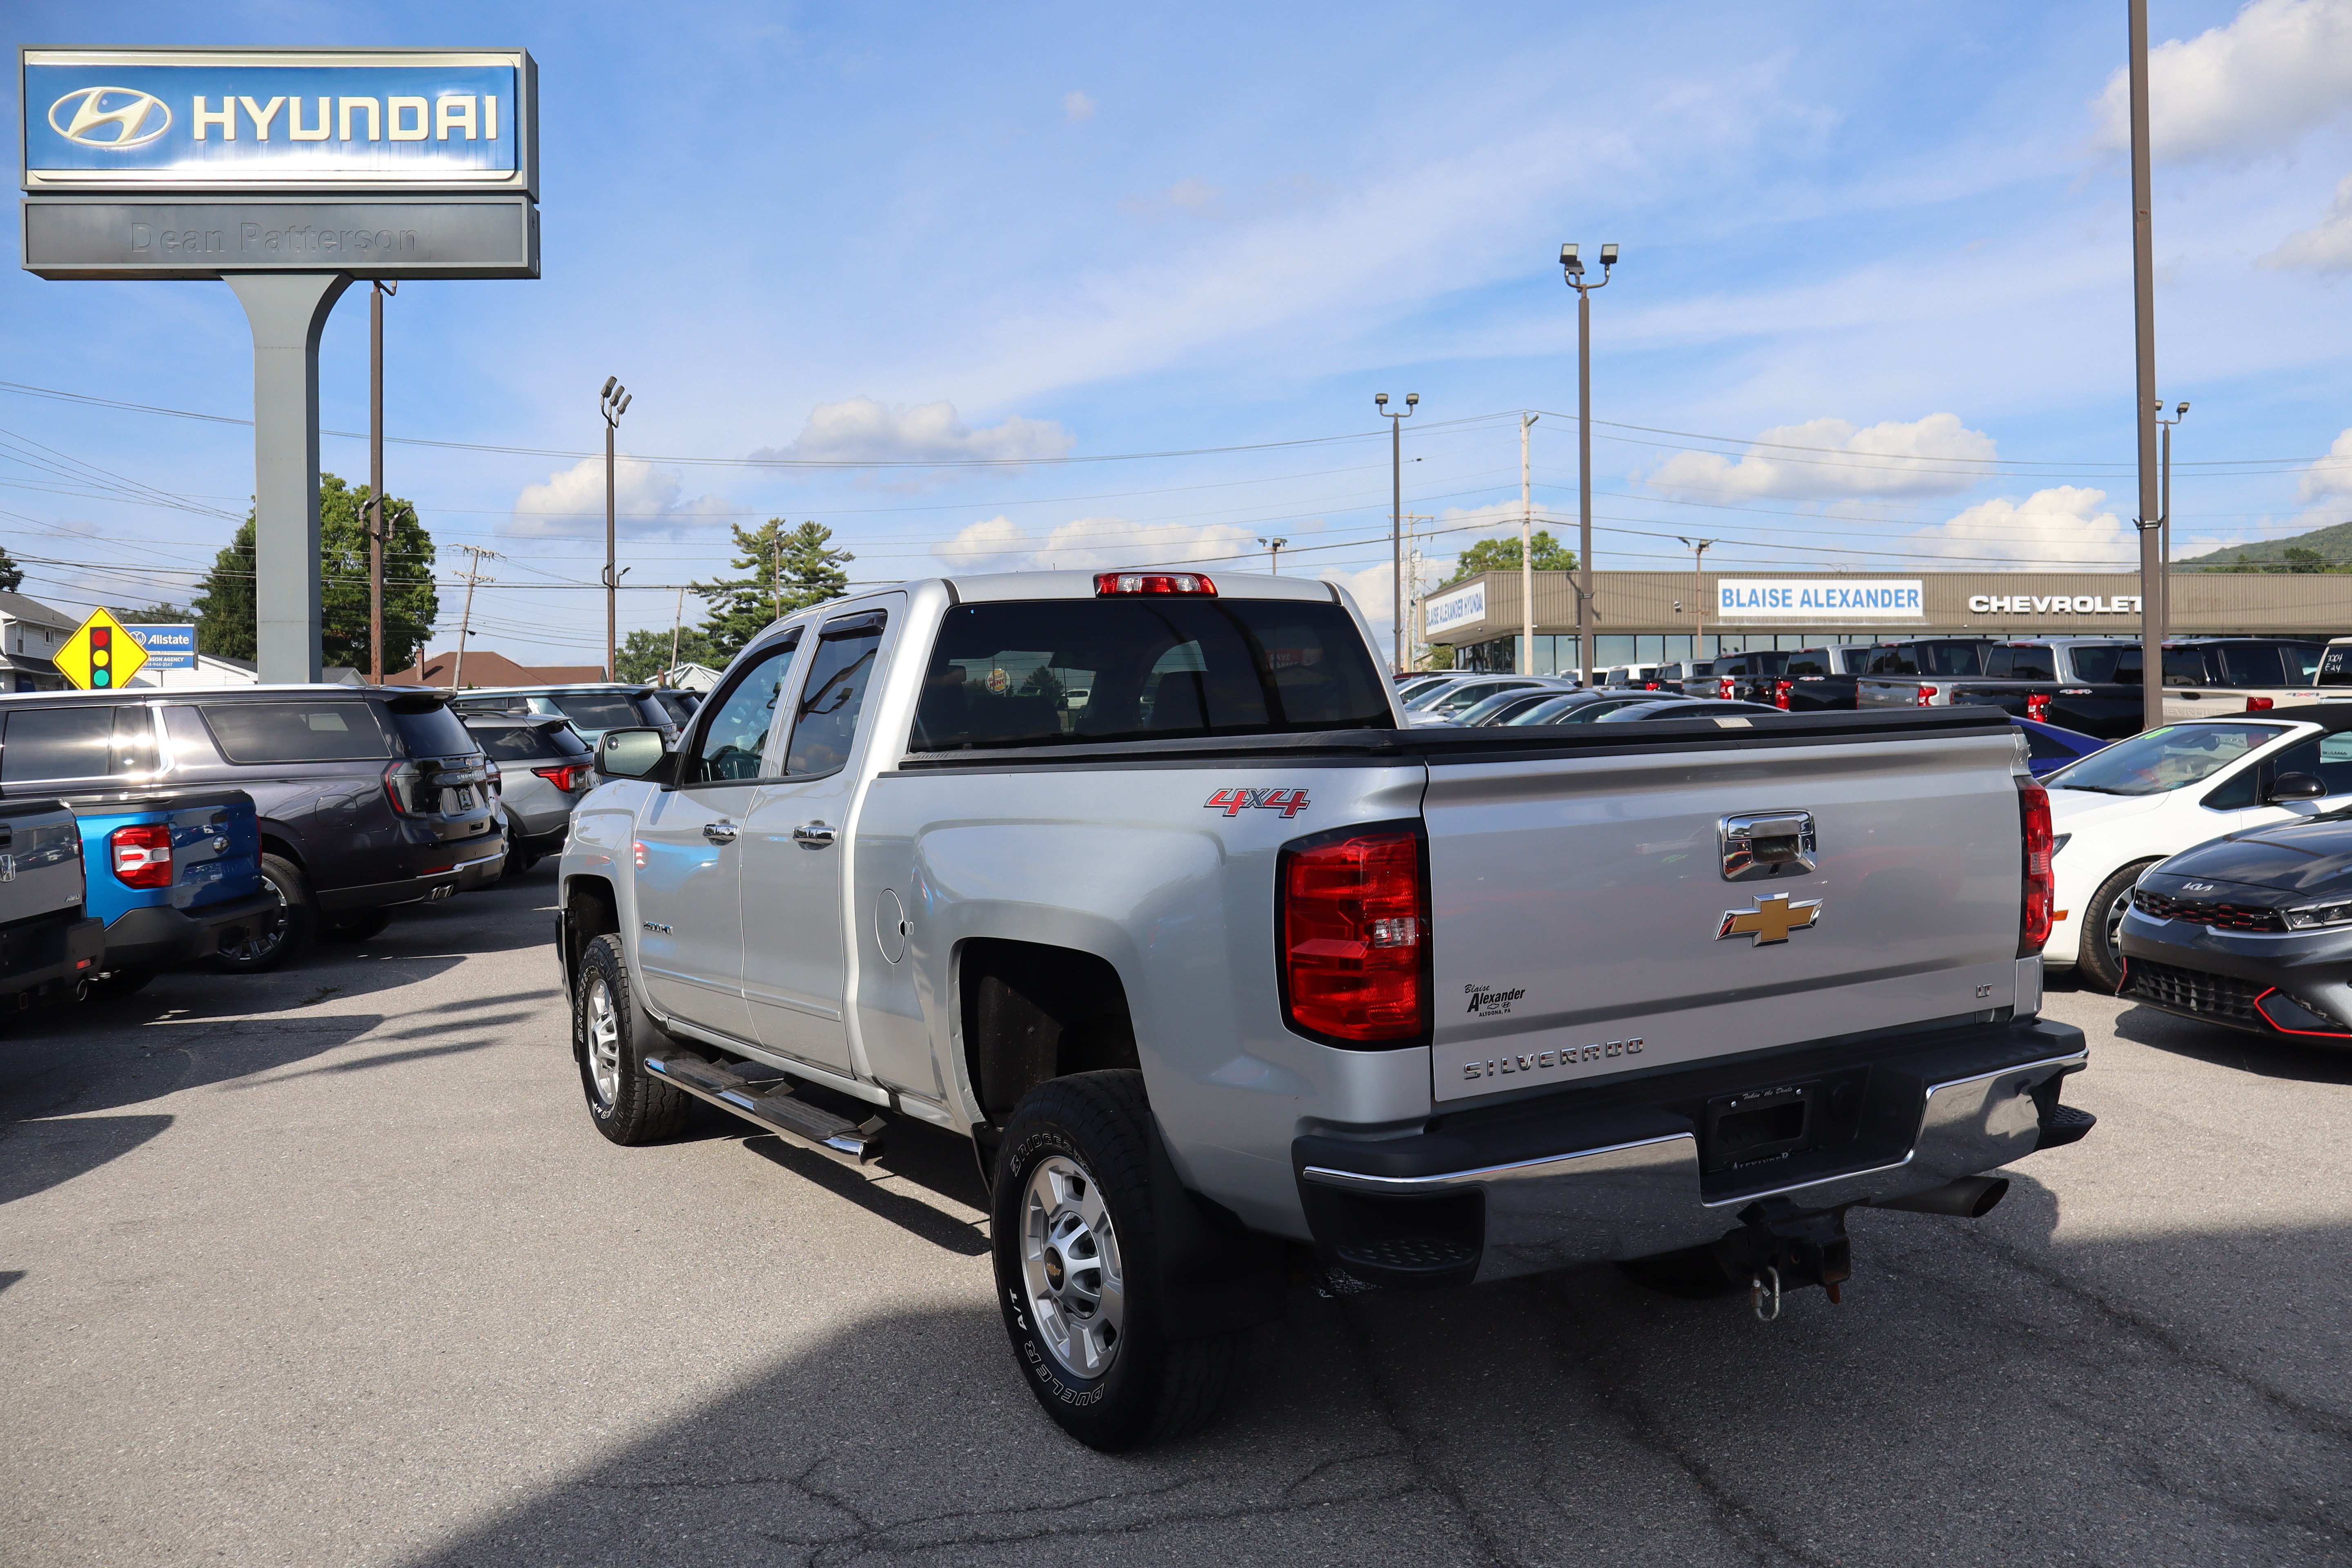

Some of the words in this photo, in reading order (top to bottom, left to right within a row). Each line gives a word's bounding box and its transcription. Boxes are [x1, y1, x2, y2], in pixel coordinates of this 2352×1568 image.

[194, 96, 497, 141] HYUNDAI
[131, 222, 225, 253] Dean
[240, 221, 419, 253] Patterson
[1722, 588, 1793, 608] BLAISE
[1800, 589, 1919, 608] ALEXANDER
[148, 635, 189, 644] Allstate
[1464, 984, 1490, 993] Blaise
[1467, 988, 1526, 1013] Alexander
[1976, 983, 1992, 998] LT
[1464, 1037, 1643, 1080] SILVERADO
[1025, 1341, 1105, 1405] DUELER
